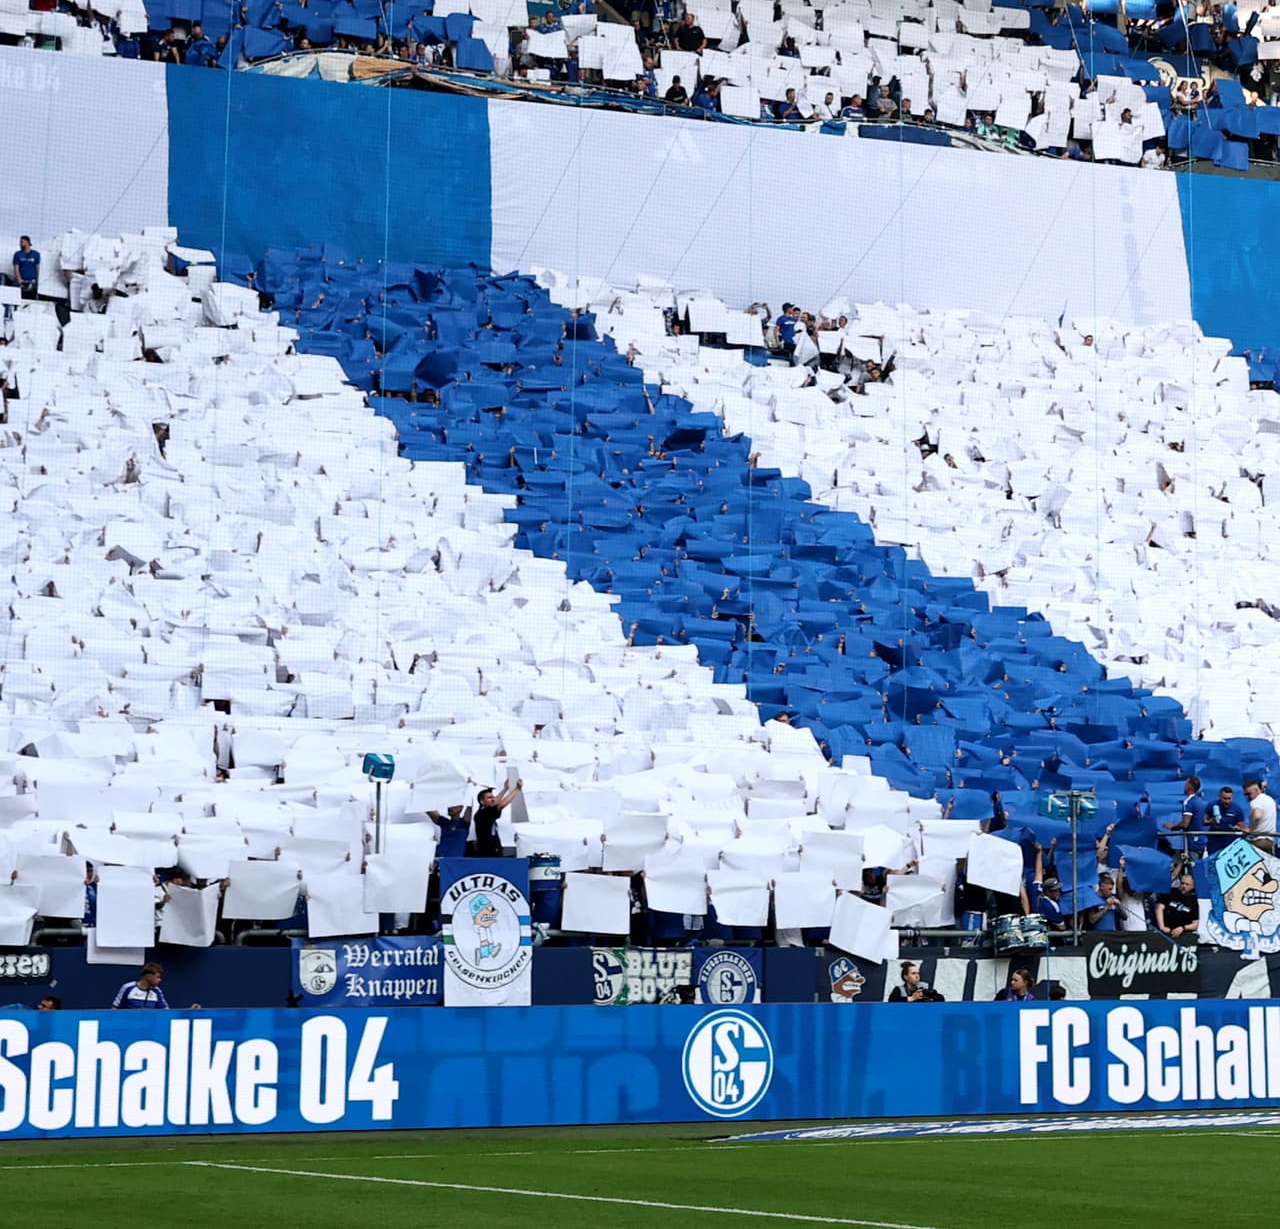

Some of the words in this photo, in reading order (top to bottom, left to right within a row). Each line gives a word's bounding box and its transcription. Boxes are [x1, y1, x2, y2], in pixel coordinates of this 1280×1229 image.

[449, 874, 521, 903] ULTRAS
[342, 944, 439, 968] Werratal
[447, 949, 528, 984] GELSENKIRCHEN
[627, 951, 693, 978] BLUE
[1089, 940, 1179, 988] Original
[1178, 944, 1198, 973] 75
[344, 973, 438, 1001] Knappen
[627, 977, 690, 1003] BOY
[300, 1015, 400, 1125] 04
[1020, 1007, 1091, 1106] FC
